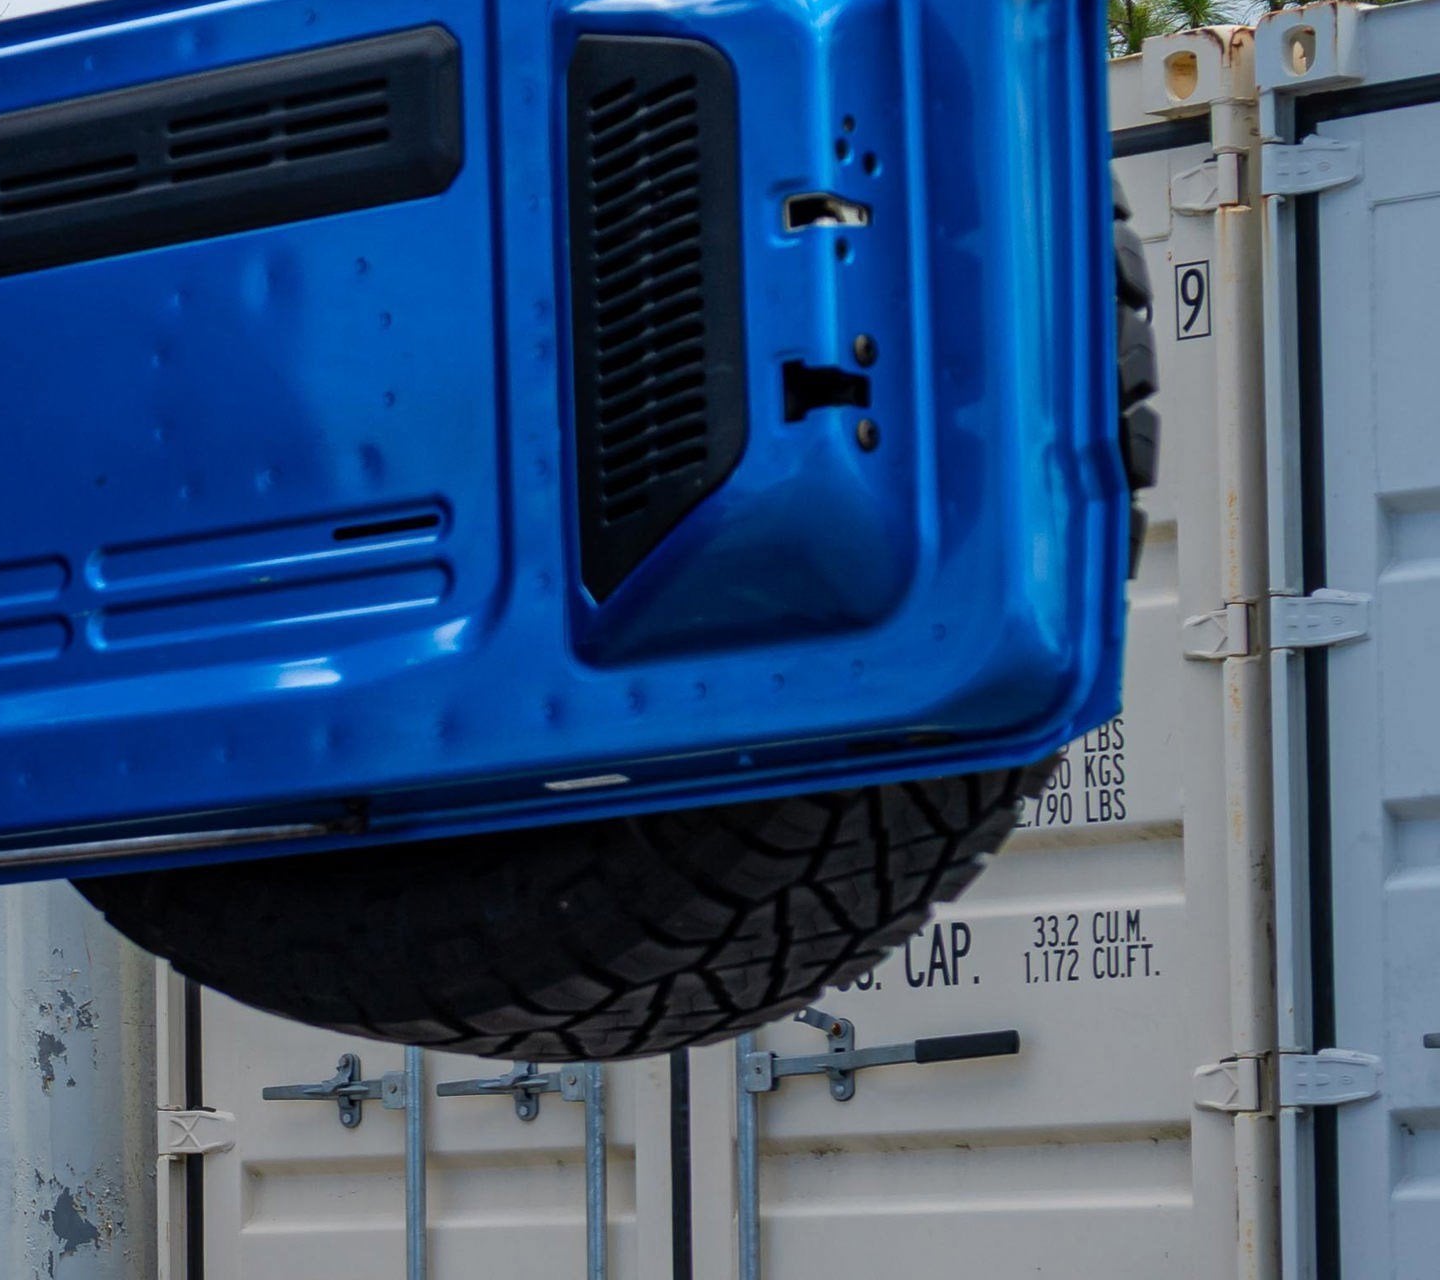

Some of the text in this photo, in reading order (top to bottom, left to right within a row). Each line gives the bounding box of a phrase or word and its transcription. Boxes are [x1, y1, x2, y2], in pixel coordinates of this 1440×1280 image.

[1181, 268, 1205, 332] 9
[1084, 718, 1125, 753] LBS
[1084, 753, 1126, 788] KGS
[1085, 788, 1127, 823] LBS
[1033, 909, 1148, 948] 33.2 CU.M.
[904, 921, 981, 988] CAP.
[1024, 943, 1161, 984] 1,172 CU.FT.
